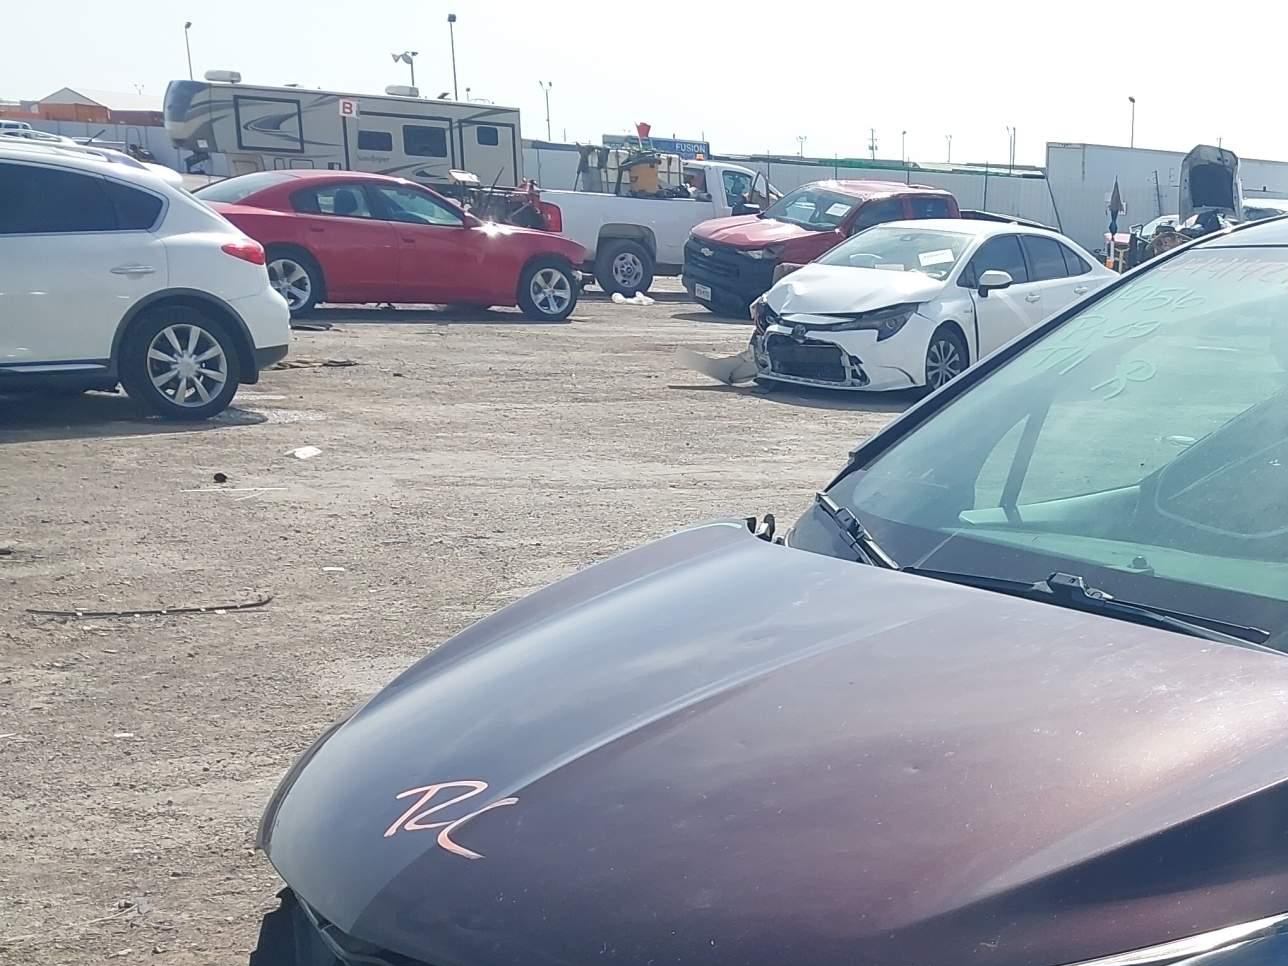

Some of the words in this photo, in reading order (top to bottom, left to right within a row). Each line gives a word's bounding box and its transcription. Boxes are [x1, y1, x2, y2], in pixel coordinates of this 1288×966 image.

[342, 101, 353, 114] B
[675, 143, 706, 153] FUSION
[383, 780, 519, 860] RC
